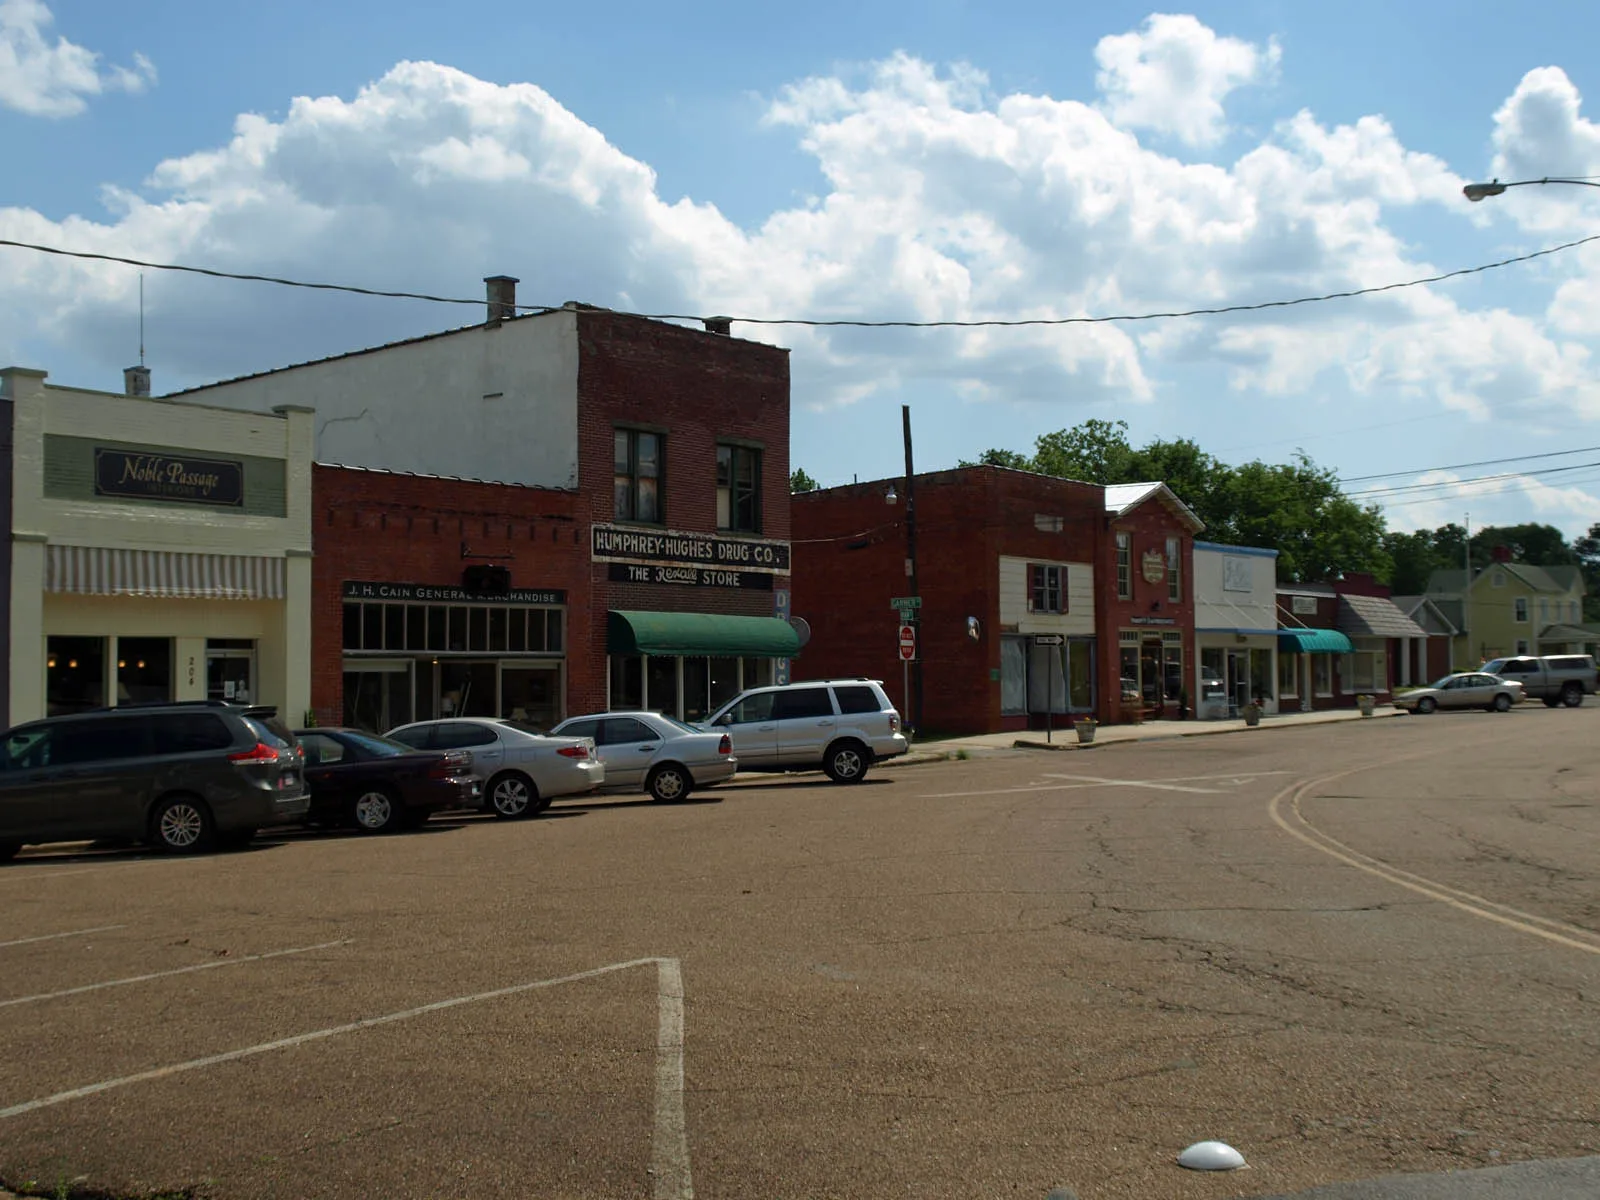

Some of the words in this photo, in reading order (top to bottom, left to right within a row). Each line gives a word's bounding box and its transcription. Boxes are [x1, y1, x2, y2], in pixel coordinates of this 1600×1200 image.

[118, 456, 163, 484] Noble
[166, 462, 219, 496] Passage
[596, 532, 713, 559] HUMPHREY-HUGHES
[718, 543, 749, 561] DRUG
[754, 547, 780, 563] CO.
[348, 585, 358, 595] J.
[362, 586, 374, 596] H.
[379, 586, 411, 598] CAIN
[628, 566, 649, 581] THE
[655, 566, 698, 584] Rexall
[703, 571, 740, 586] STORE
[776, 592, 786, 685] DGS
